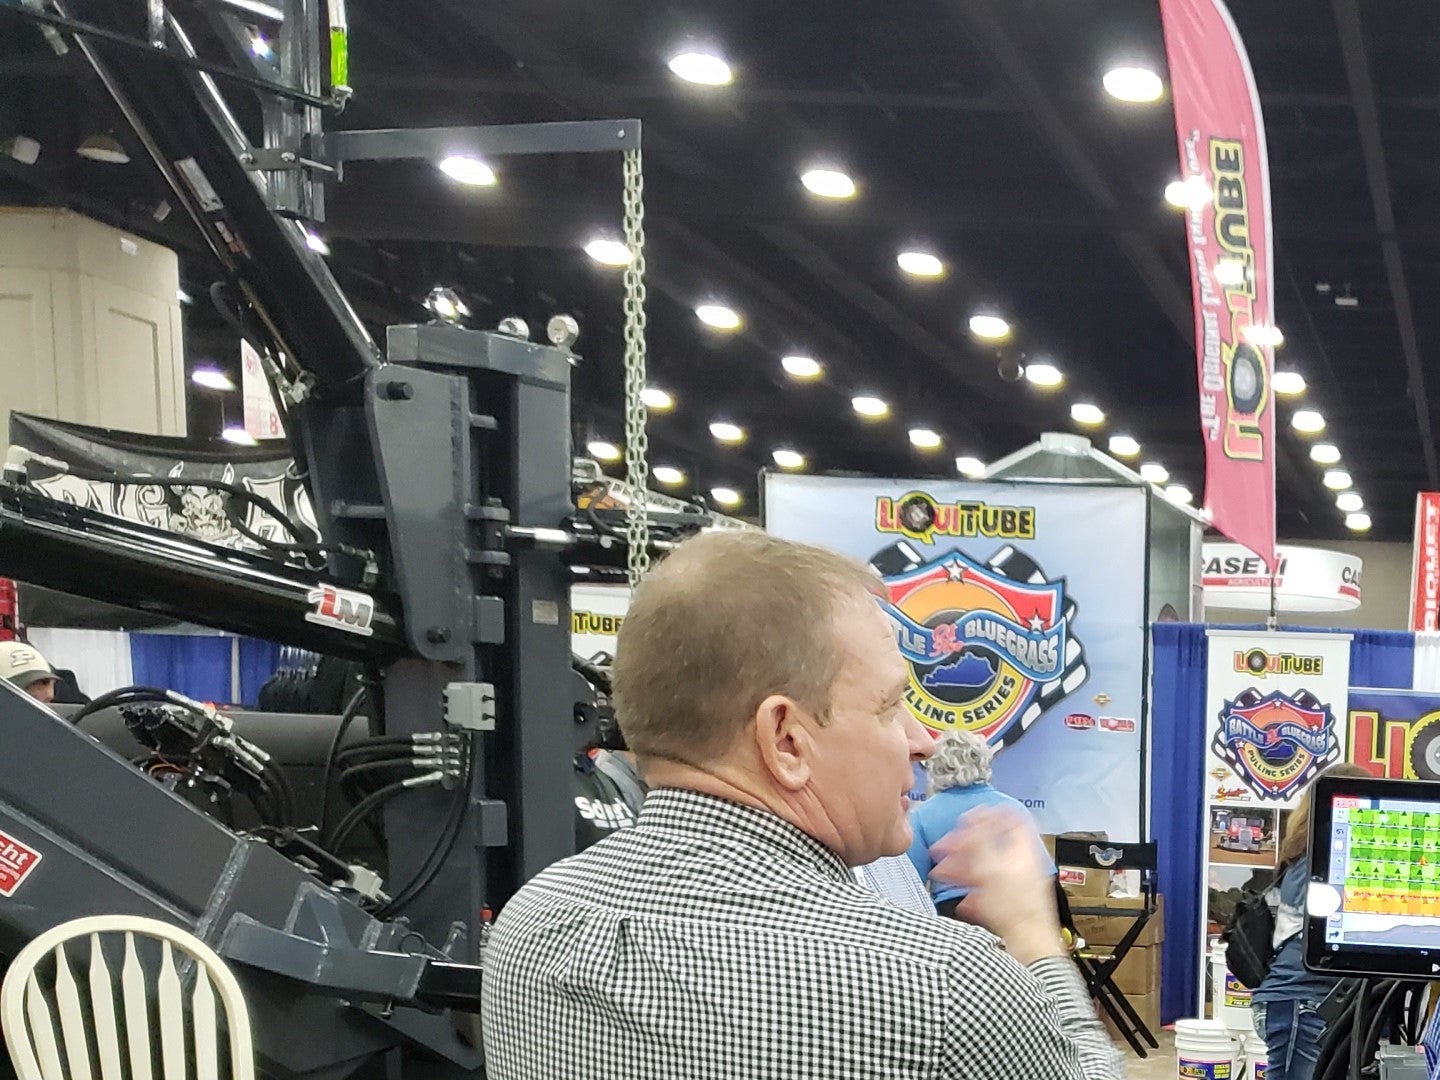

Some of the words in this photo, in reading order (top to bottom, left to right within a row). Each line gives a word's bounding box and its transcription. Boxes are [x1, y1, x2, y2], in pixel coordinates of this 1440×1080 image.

[876, 490, 1036, 545] LIQUITUBE
[964, 619, 1060, 674] BLUEGRASS
[1233, 647, 1324, 680] LIQUITUBE
[903, 682, 955, 724] LLING
[962, 676, 1016, 725] SERIES
[1247, 749, 1277, 777] PULLING
[1280, 752, 1305, 778] SERIES
